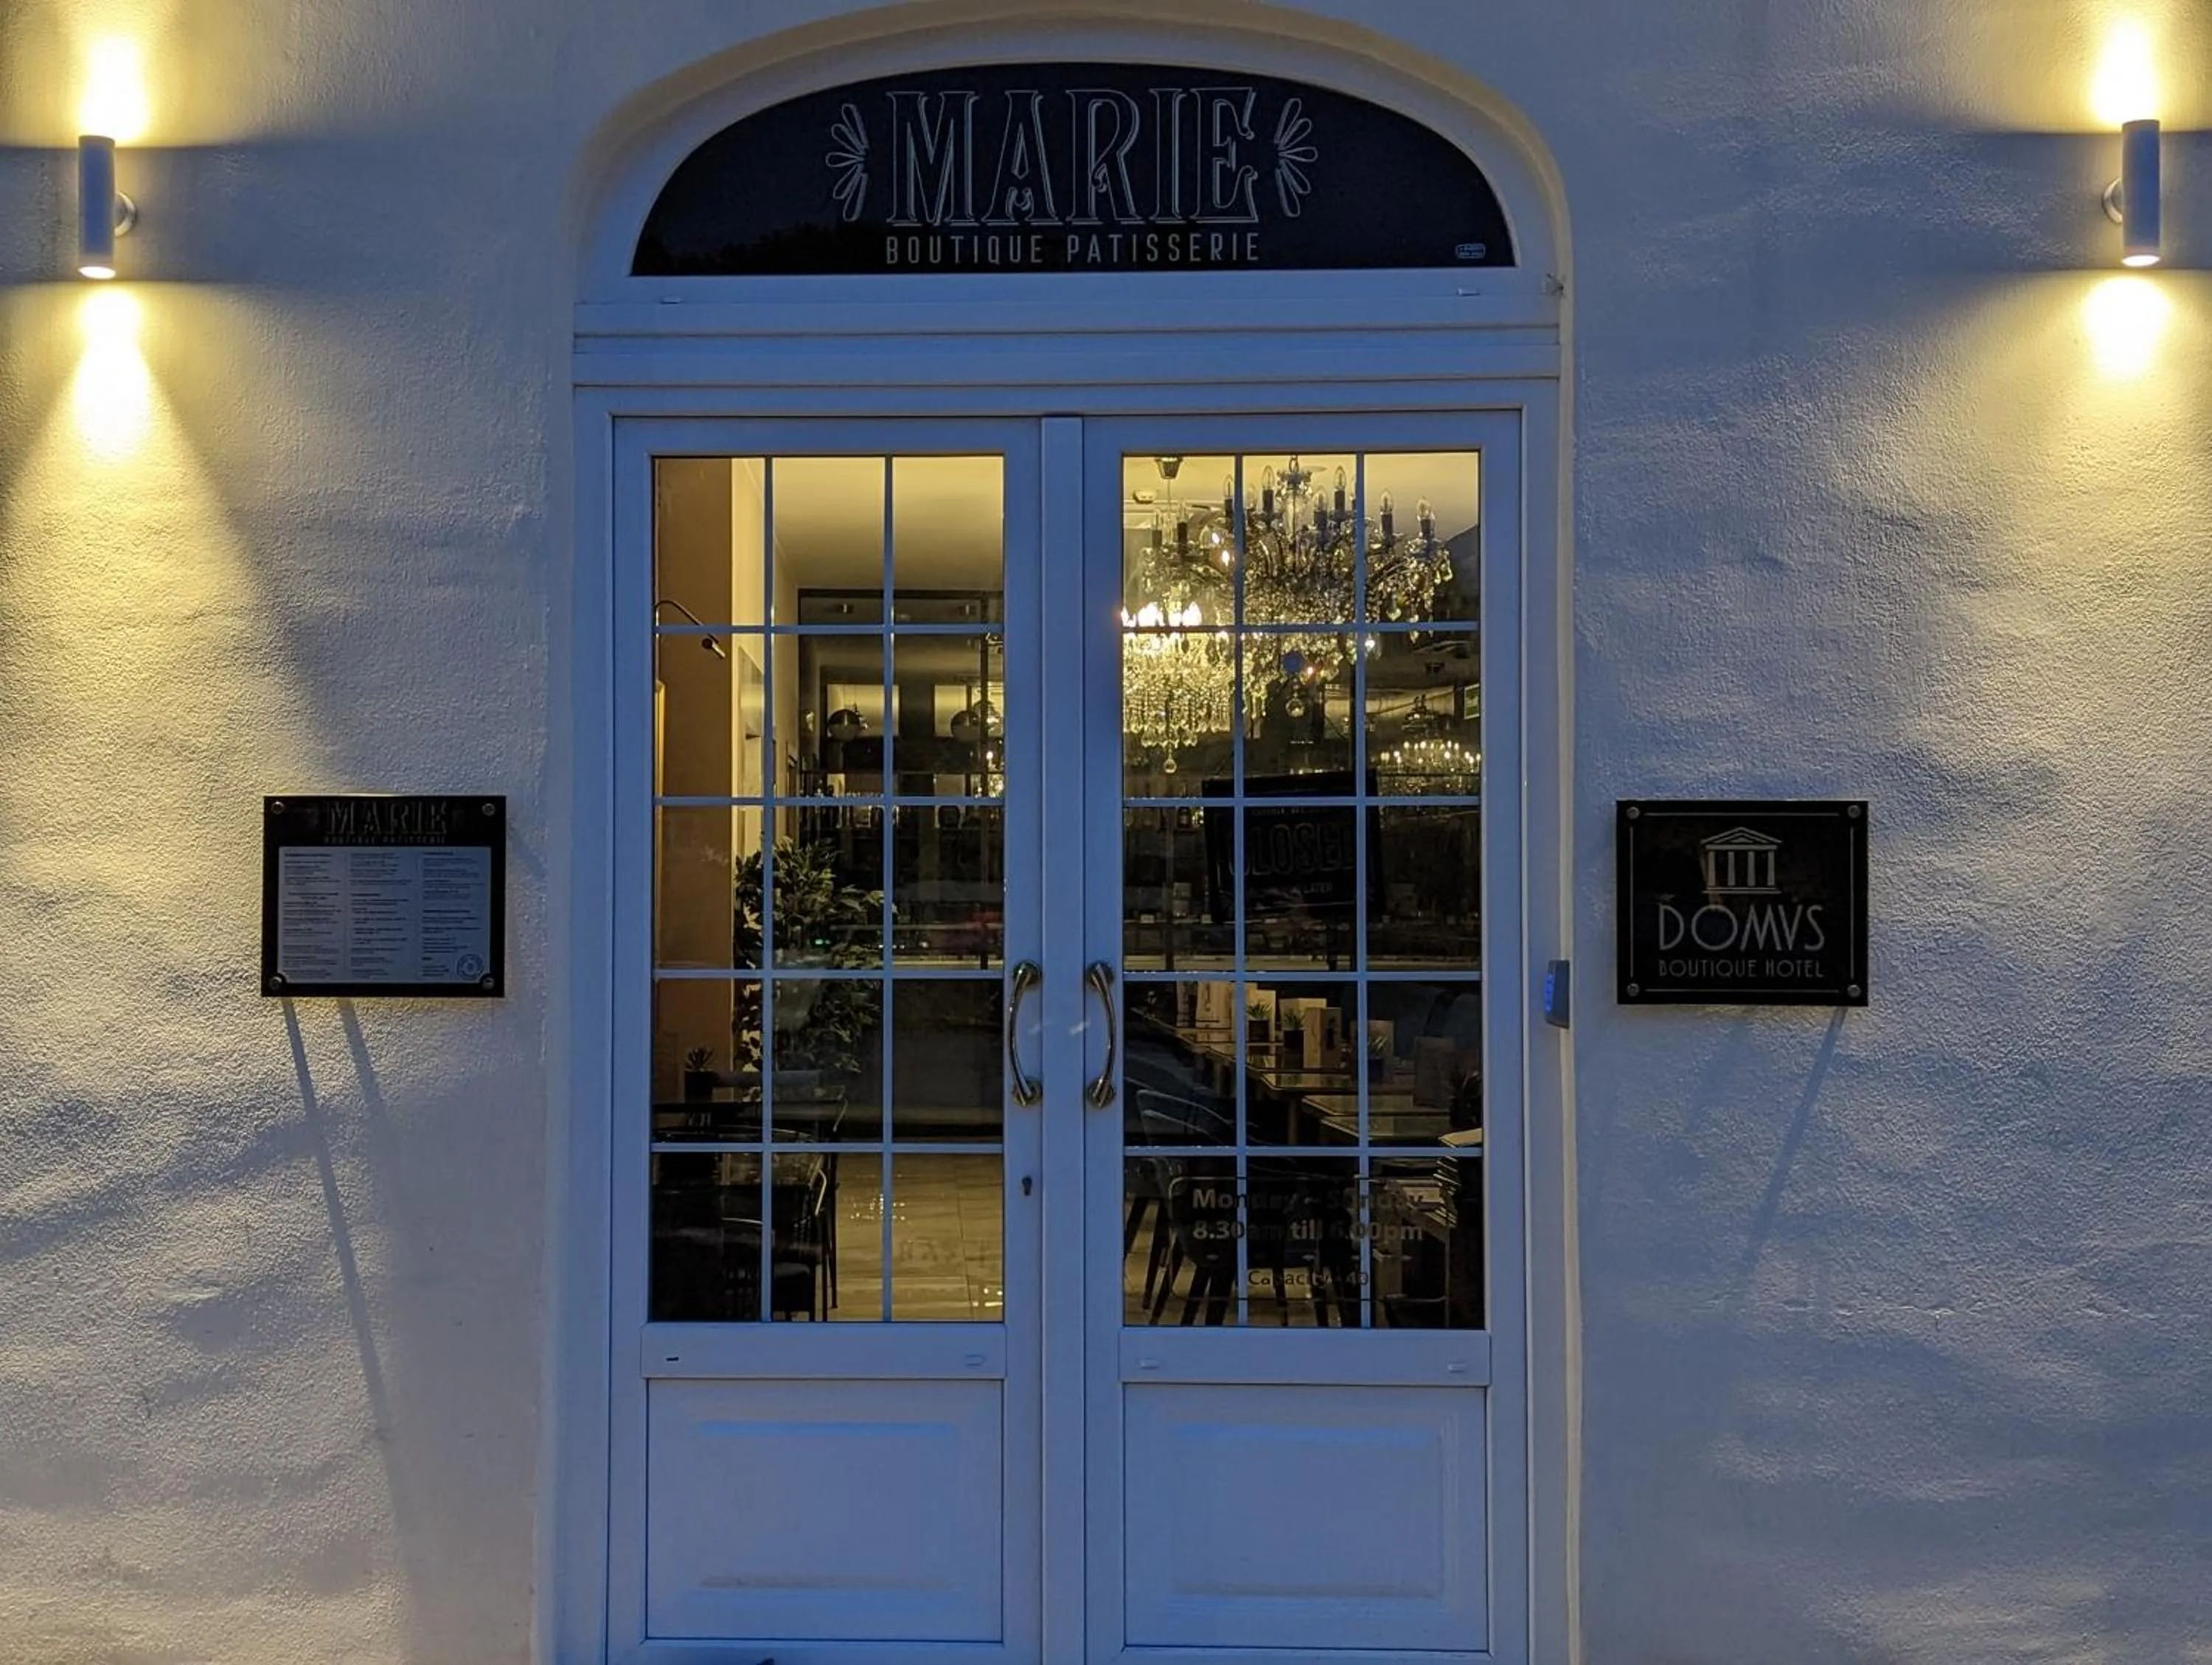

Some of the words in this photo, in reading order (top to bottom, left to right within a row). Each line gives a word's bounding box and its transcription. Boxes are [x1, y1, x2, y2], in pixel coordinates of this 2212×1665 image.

[886, 86, 1260, 227] MARIE
[886, 234, 1043, 265] BOUTIQUE
[1066, 232, 1260, 263] PATISSERIE
[324, 800, 448, 835] MARIE
[1659, 903, 1825, 951] DOMVS
[1659, 959, 1757, 979] BOUTIQUE
[1765, 959, 1824, 979] HOTEL
[1247, 1269, 1333, 1290] Caacity
